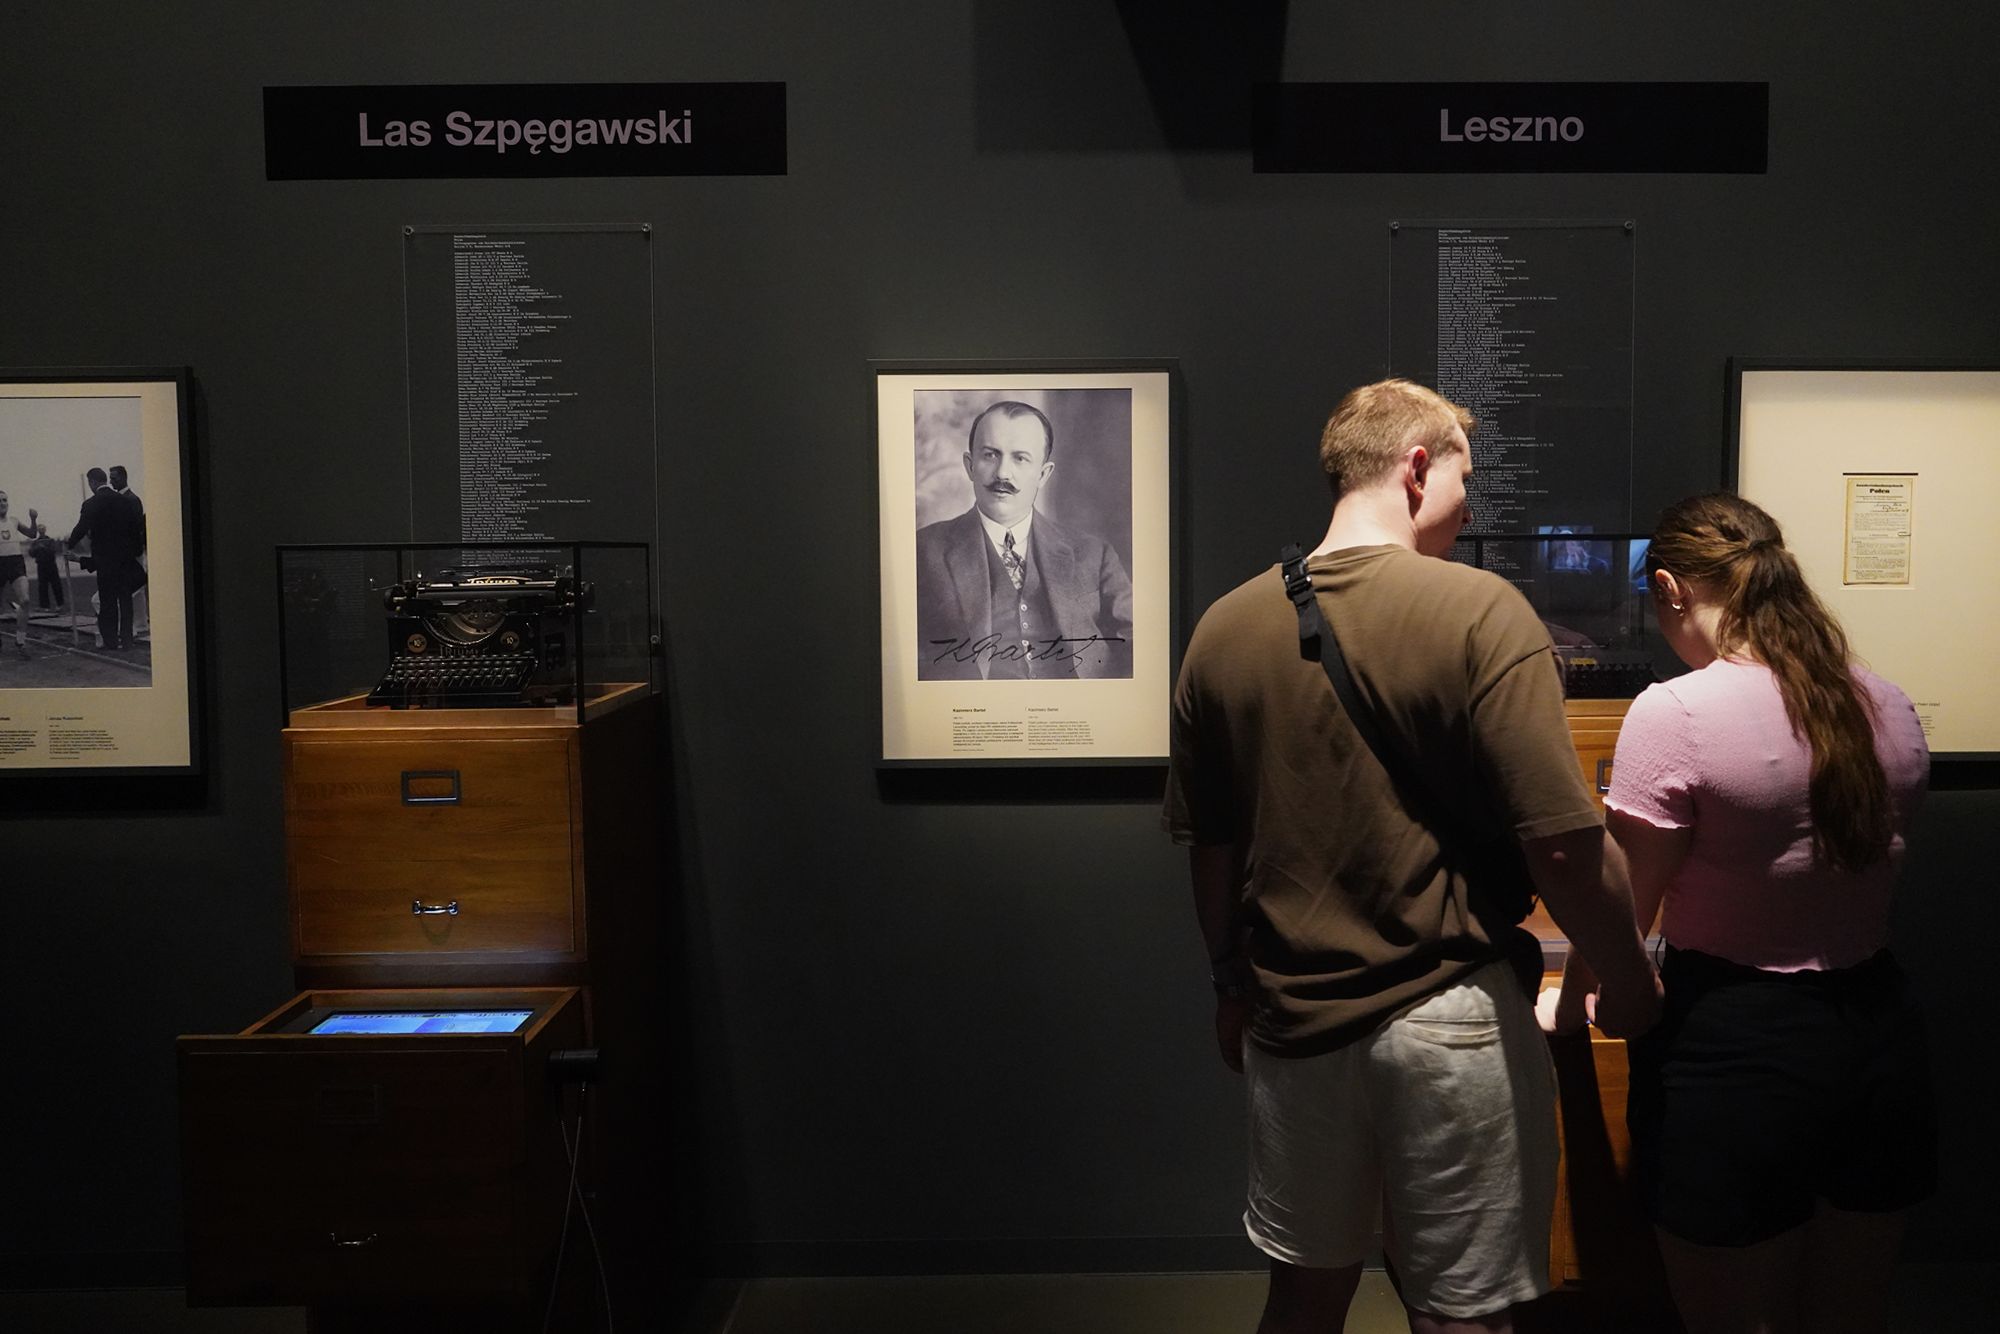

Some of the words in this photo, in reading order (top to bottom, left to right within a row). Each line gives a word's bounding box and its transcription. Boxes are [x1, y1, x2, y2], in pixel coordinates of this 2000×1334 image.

[360, 113, 431, 146] Las
[446, 110, 691, 154] Szpęgawski
[1441, 109, 1583, 141] Leszno
